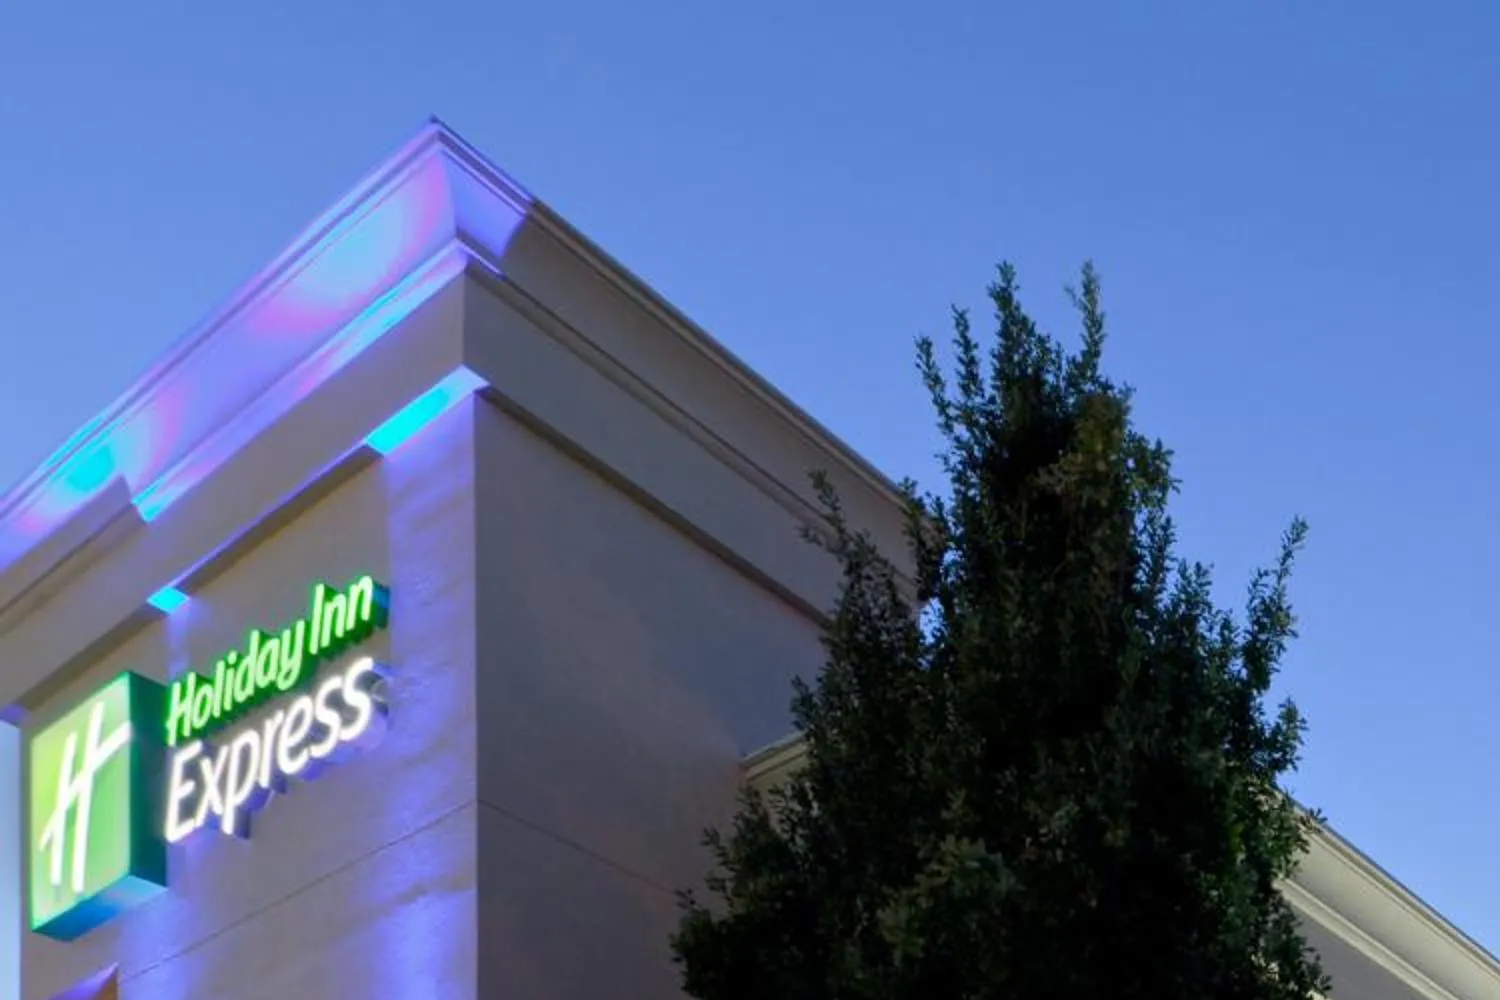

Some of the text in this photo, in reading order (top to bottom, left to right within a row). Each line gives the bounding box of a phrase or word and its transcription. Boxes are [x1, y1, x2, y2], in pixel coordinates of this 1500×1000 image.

[164, 656, 375, 844] Express
[165, 575, 375, 746] Holiday Inn
[39, 699, 132, 893] H
